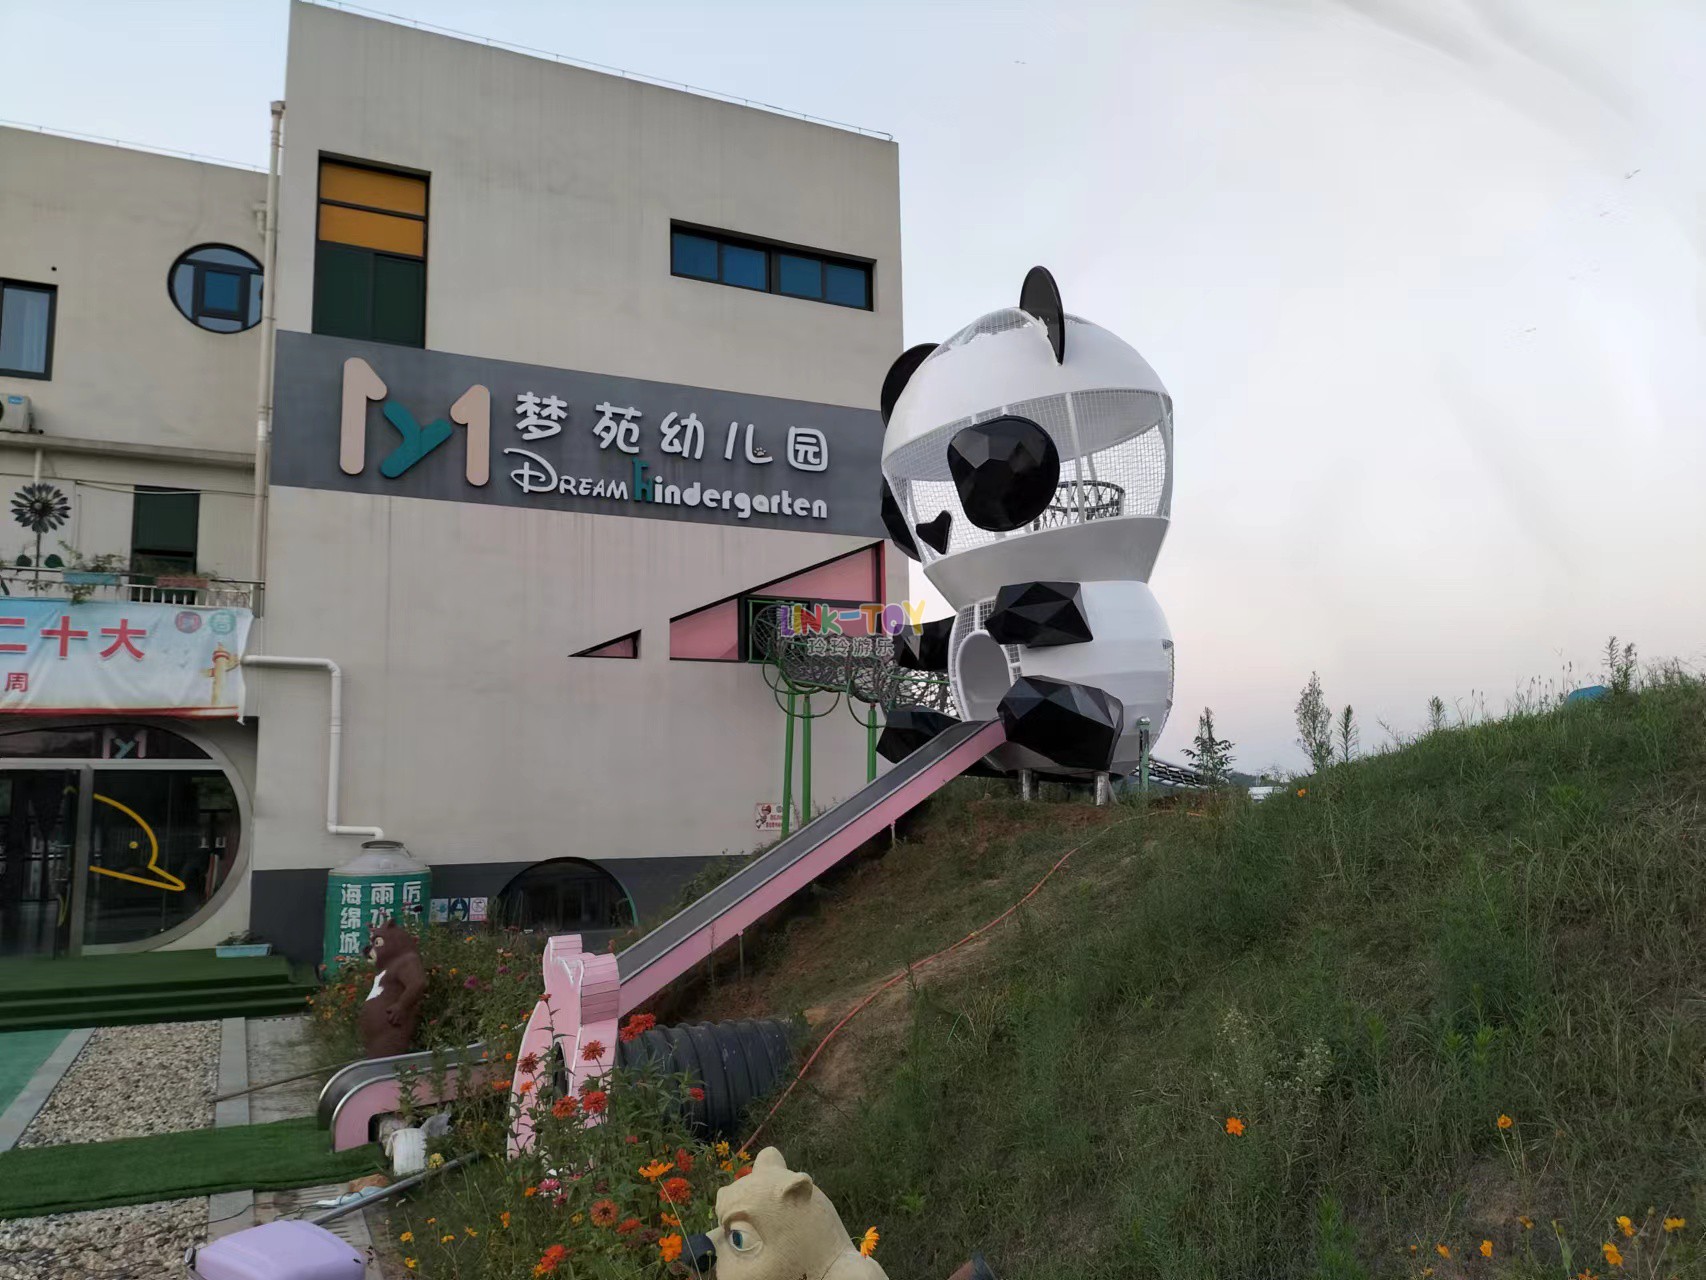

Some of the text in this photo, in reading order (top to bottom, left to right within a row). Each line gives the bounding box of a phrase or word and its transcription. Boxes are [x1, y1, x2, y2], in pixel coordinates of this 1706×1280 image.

[515, 391, 829, 473] 梦苑幼儿园
[4, 672, 29, 693] 周
[369, 882, 396, 944] 雨水
